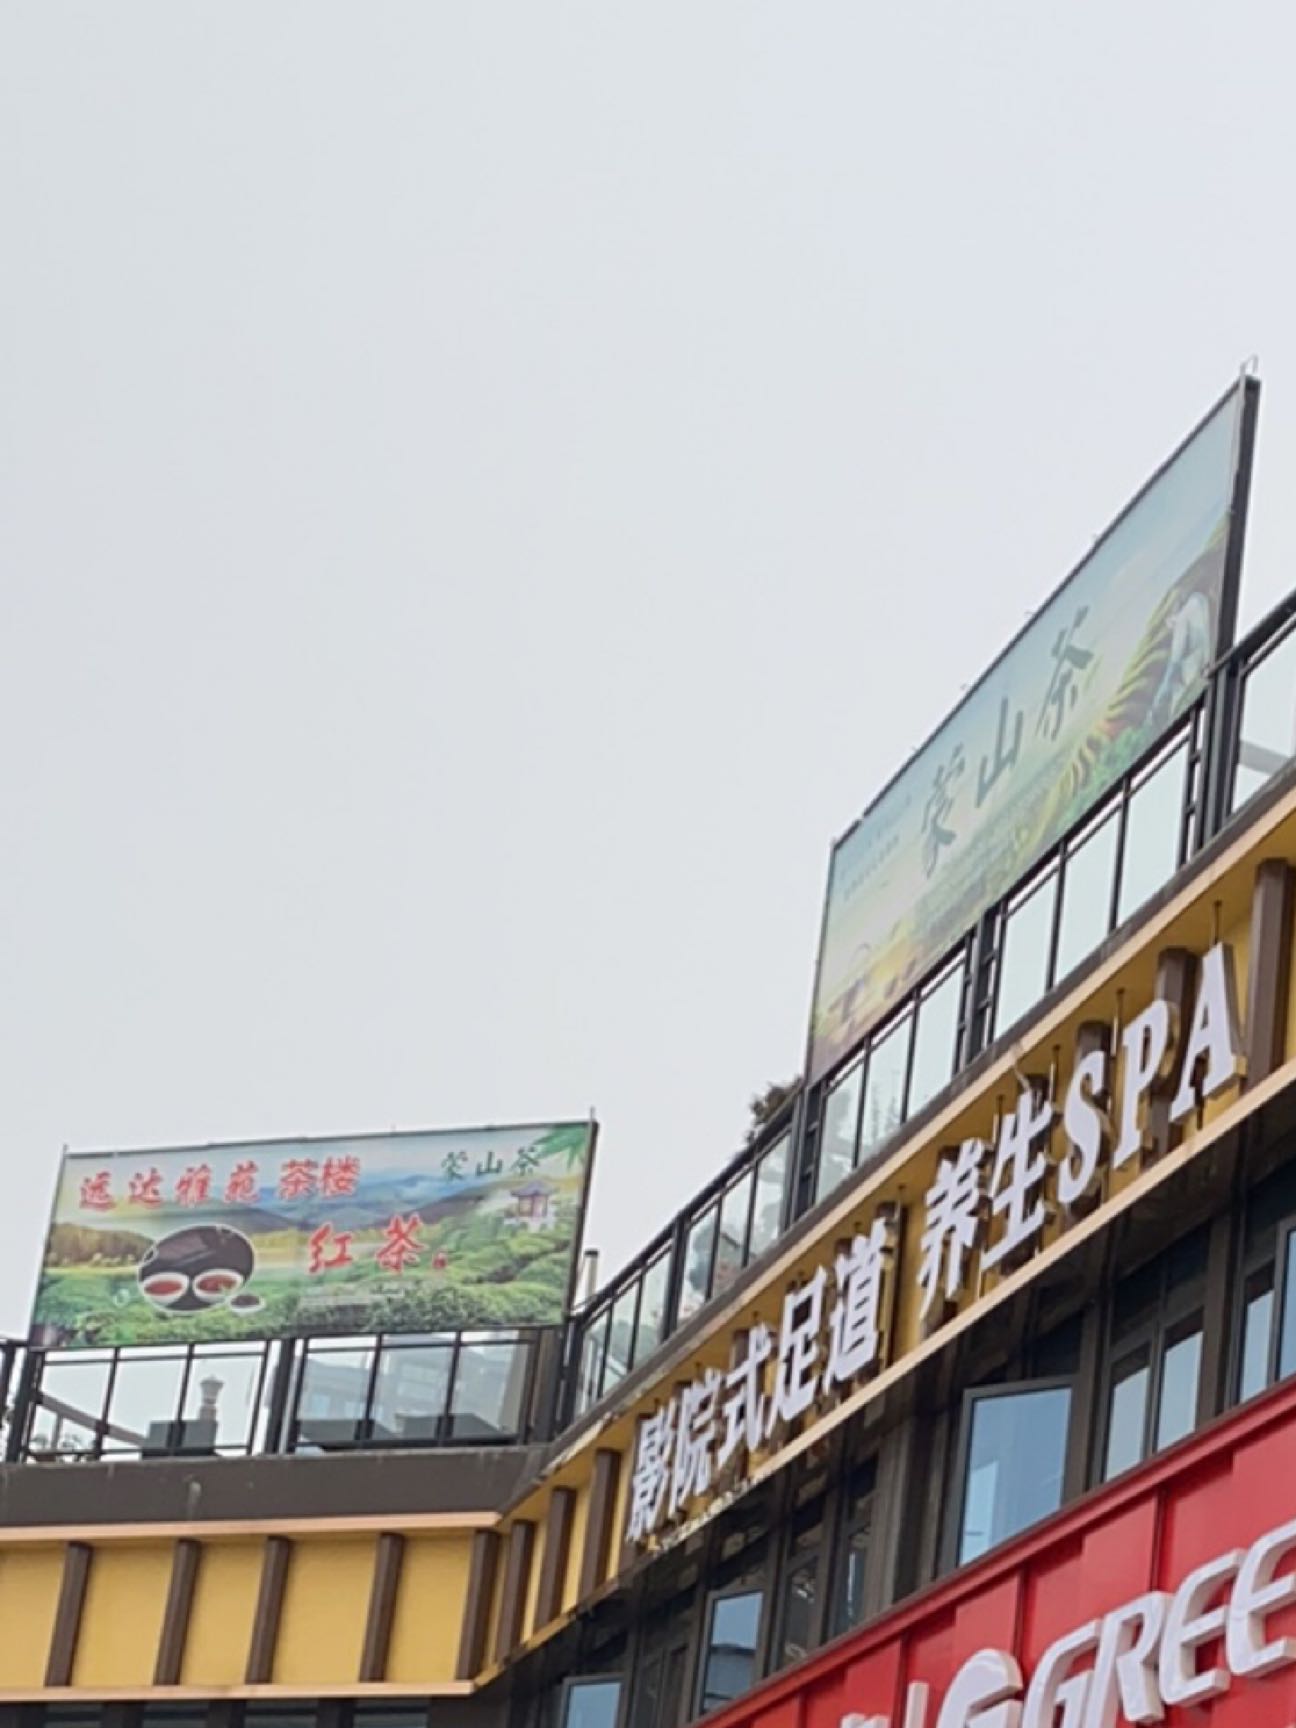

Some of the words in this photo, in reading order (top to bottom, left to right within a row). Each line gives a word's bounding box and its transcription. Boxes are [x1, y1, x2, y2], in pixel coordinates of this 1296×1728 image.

[309, 1213, 425, 1274] 红茶
[626, 1216, 888, 1542] 影院式足道
